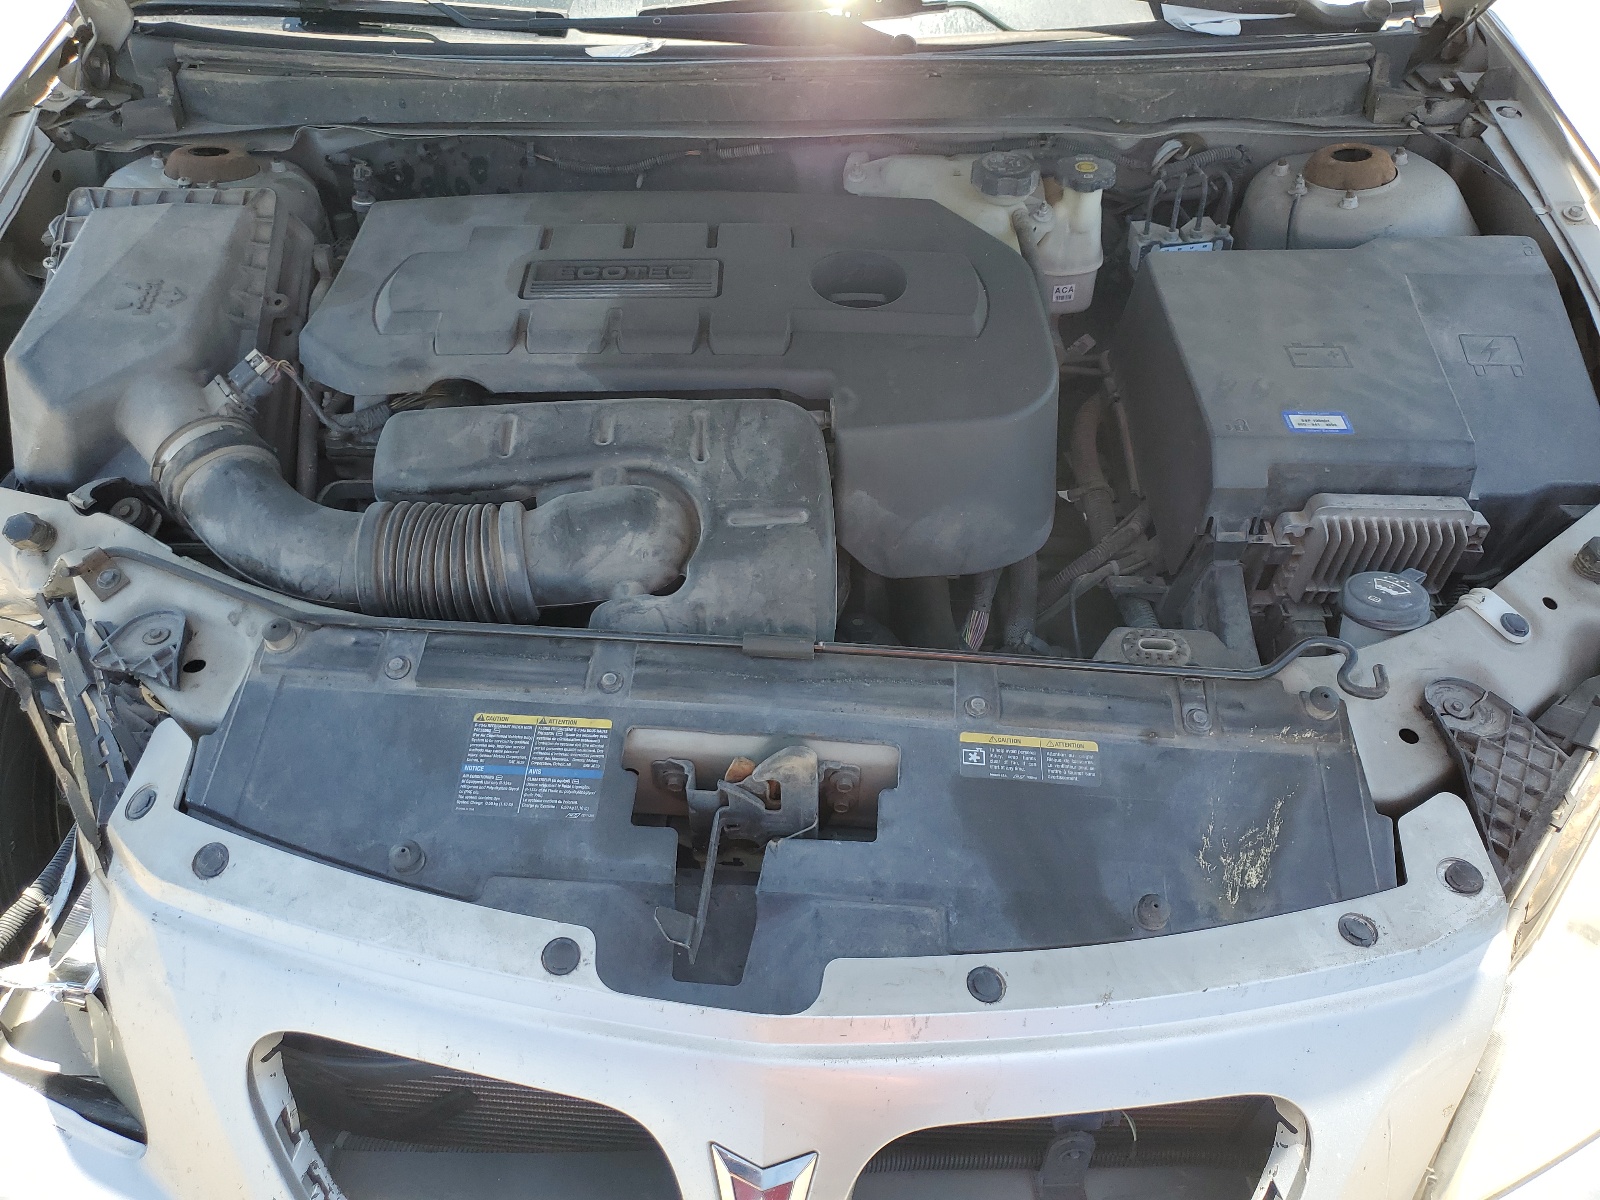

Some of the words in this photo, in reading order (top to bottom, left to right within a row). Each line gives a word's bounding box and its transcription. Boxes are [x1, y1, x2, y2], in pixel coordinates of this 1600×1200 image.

[561, 265, 693, 281] ECOTEC
[1055, 286, 1074, 294] ACA
[1055, 741, 1085, 749] ATTENTION
